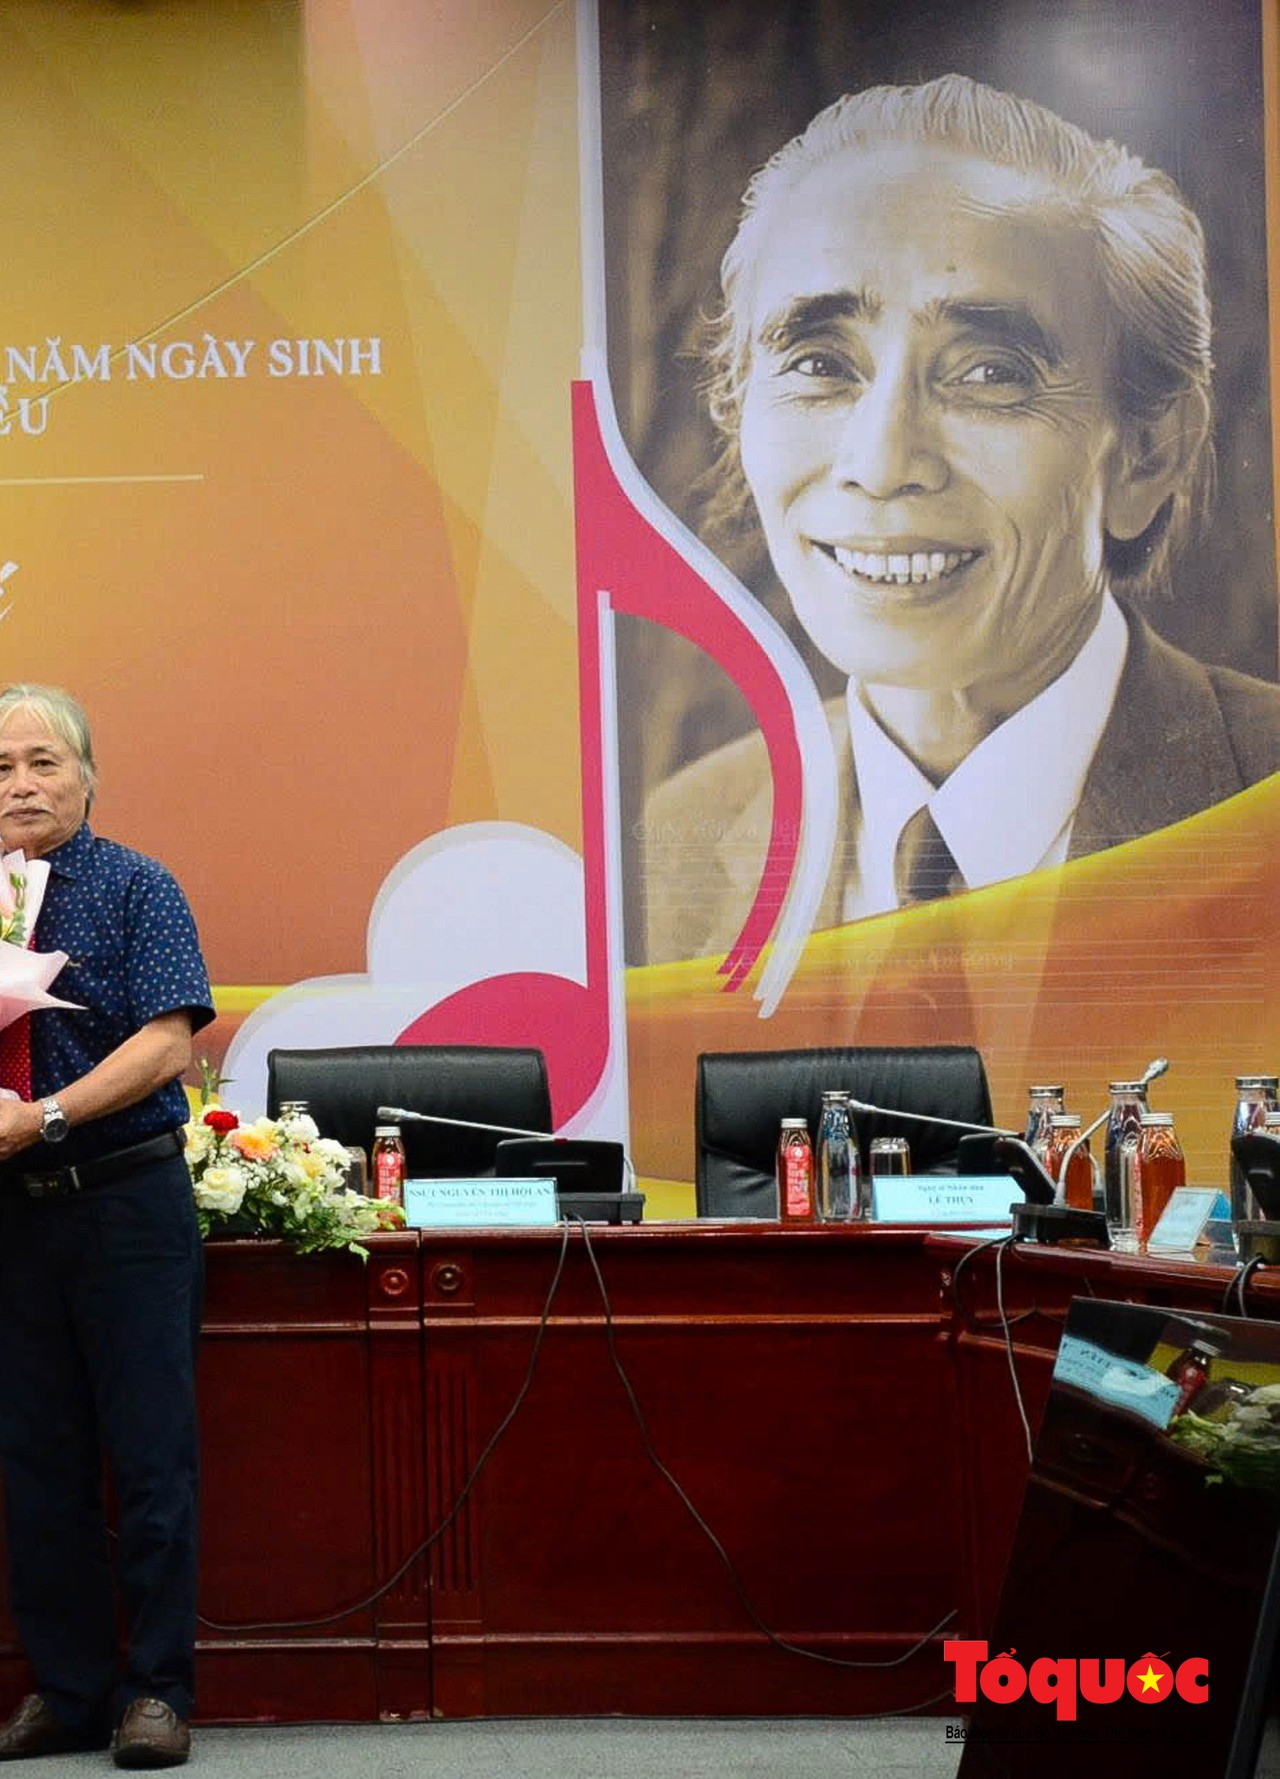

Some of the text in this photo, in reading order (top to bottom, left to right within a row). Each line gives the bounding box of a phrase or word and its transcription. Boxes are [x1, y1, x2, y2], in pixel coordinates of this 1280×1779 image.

[5, 335, 112, 384] NĂM
[124, 332, 256, 380] NGÀY
[268, 336, 382, 377] SINH
